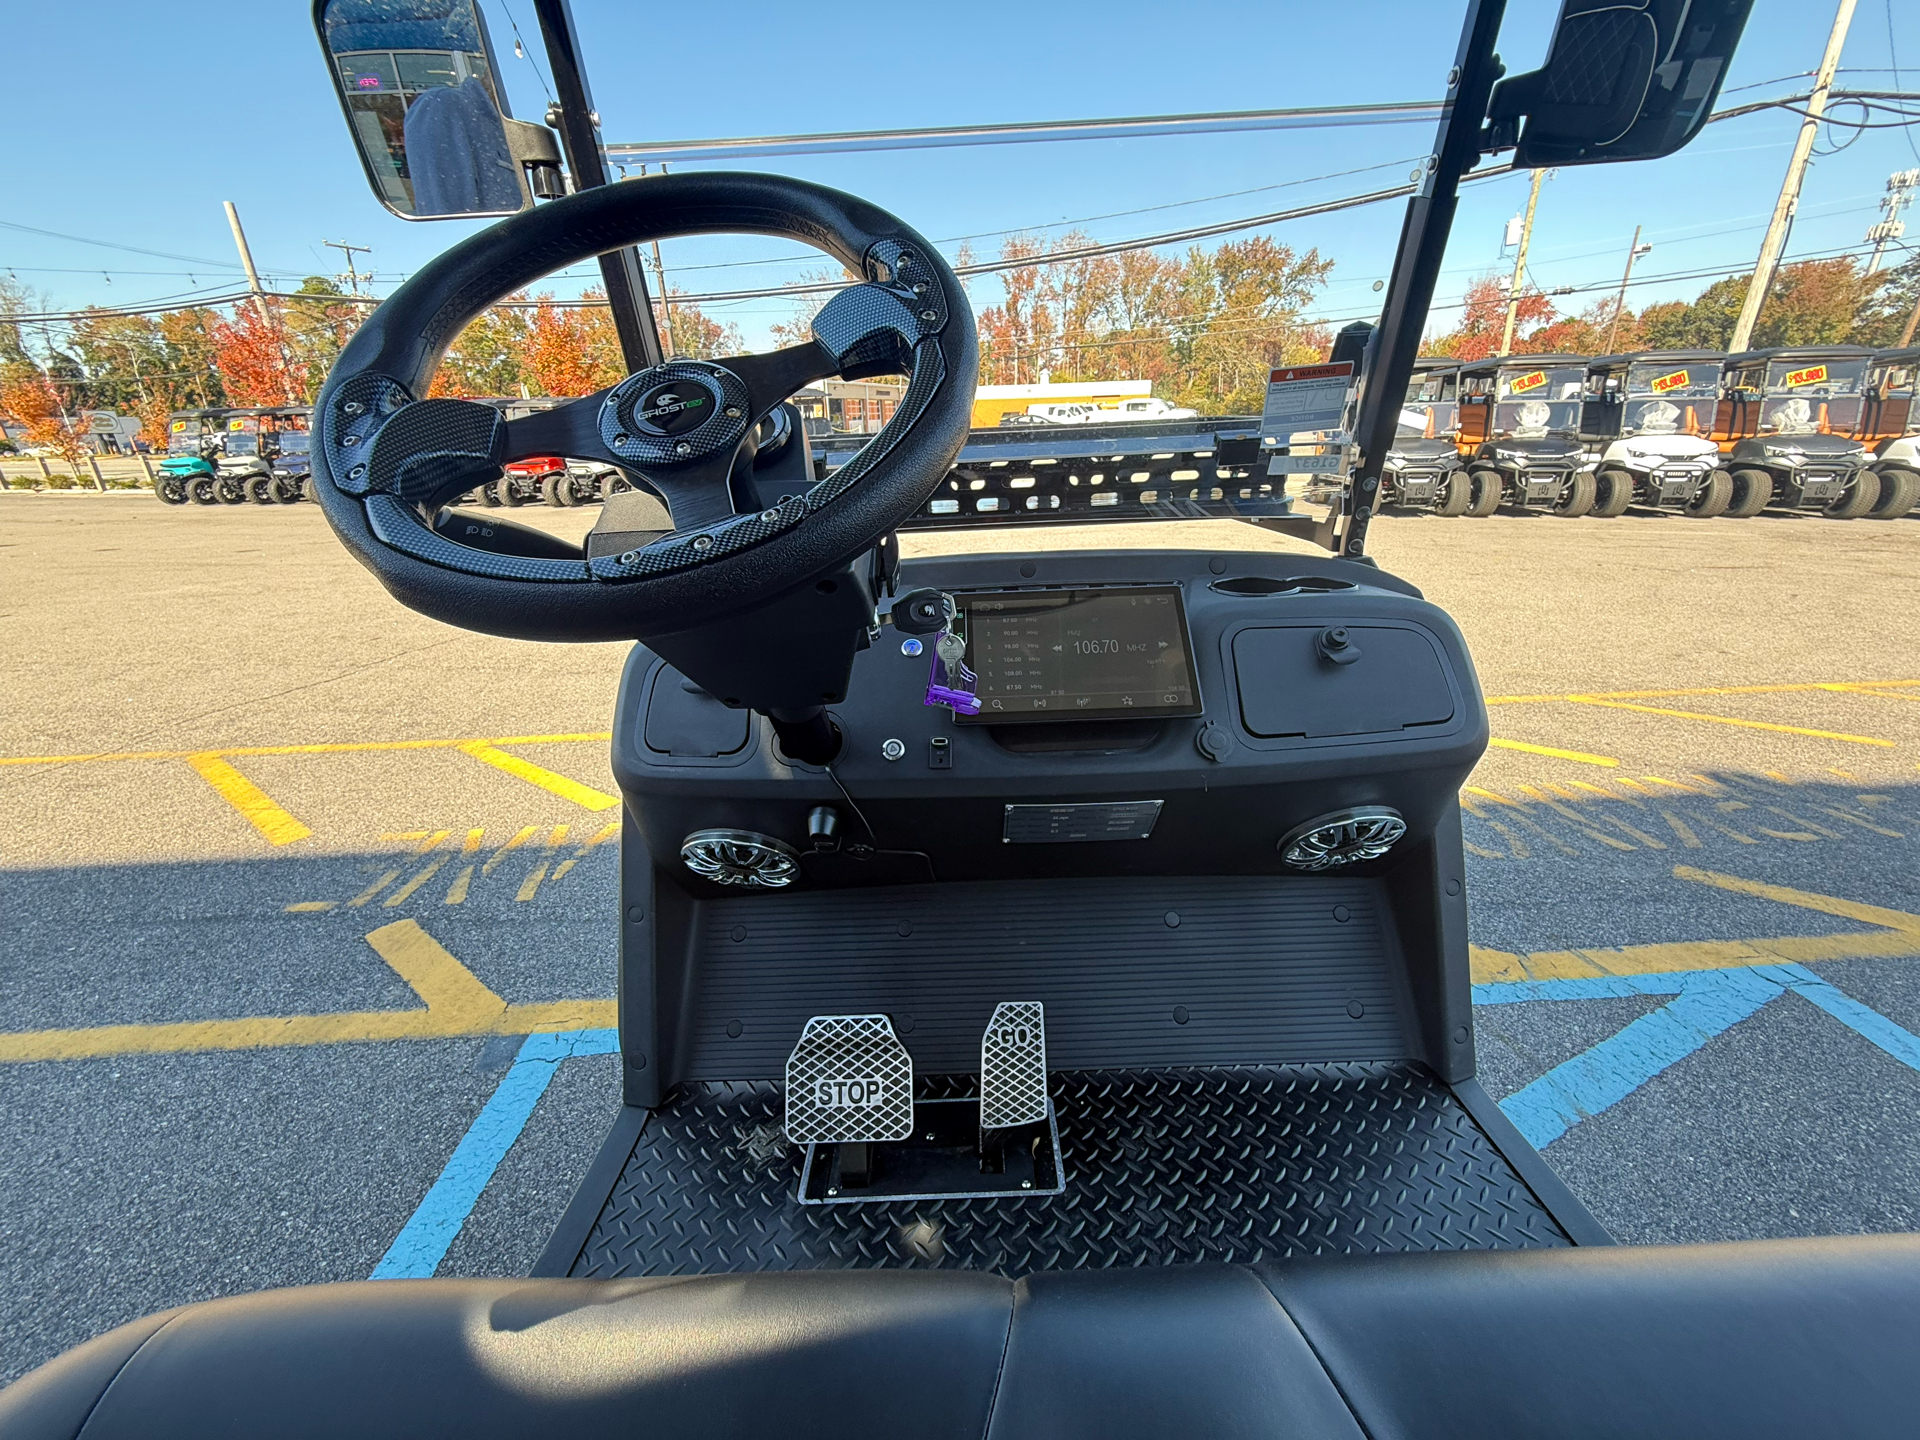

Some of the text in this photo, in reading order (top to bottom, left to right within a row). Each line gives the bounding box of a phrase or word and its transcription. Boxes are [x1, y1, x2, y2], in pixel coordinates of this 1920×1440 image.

[1300, 368, 1336, 376] WARNING
[1074, 639, 1147, 654] 106.70 MHZ
[998, 1026, 1031, 1046] GO
[818, 1080, 880, 1104] STOP
